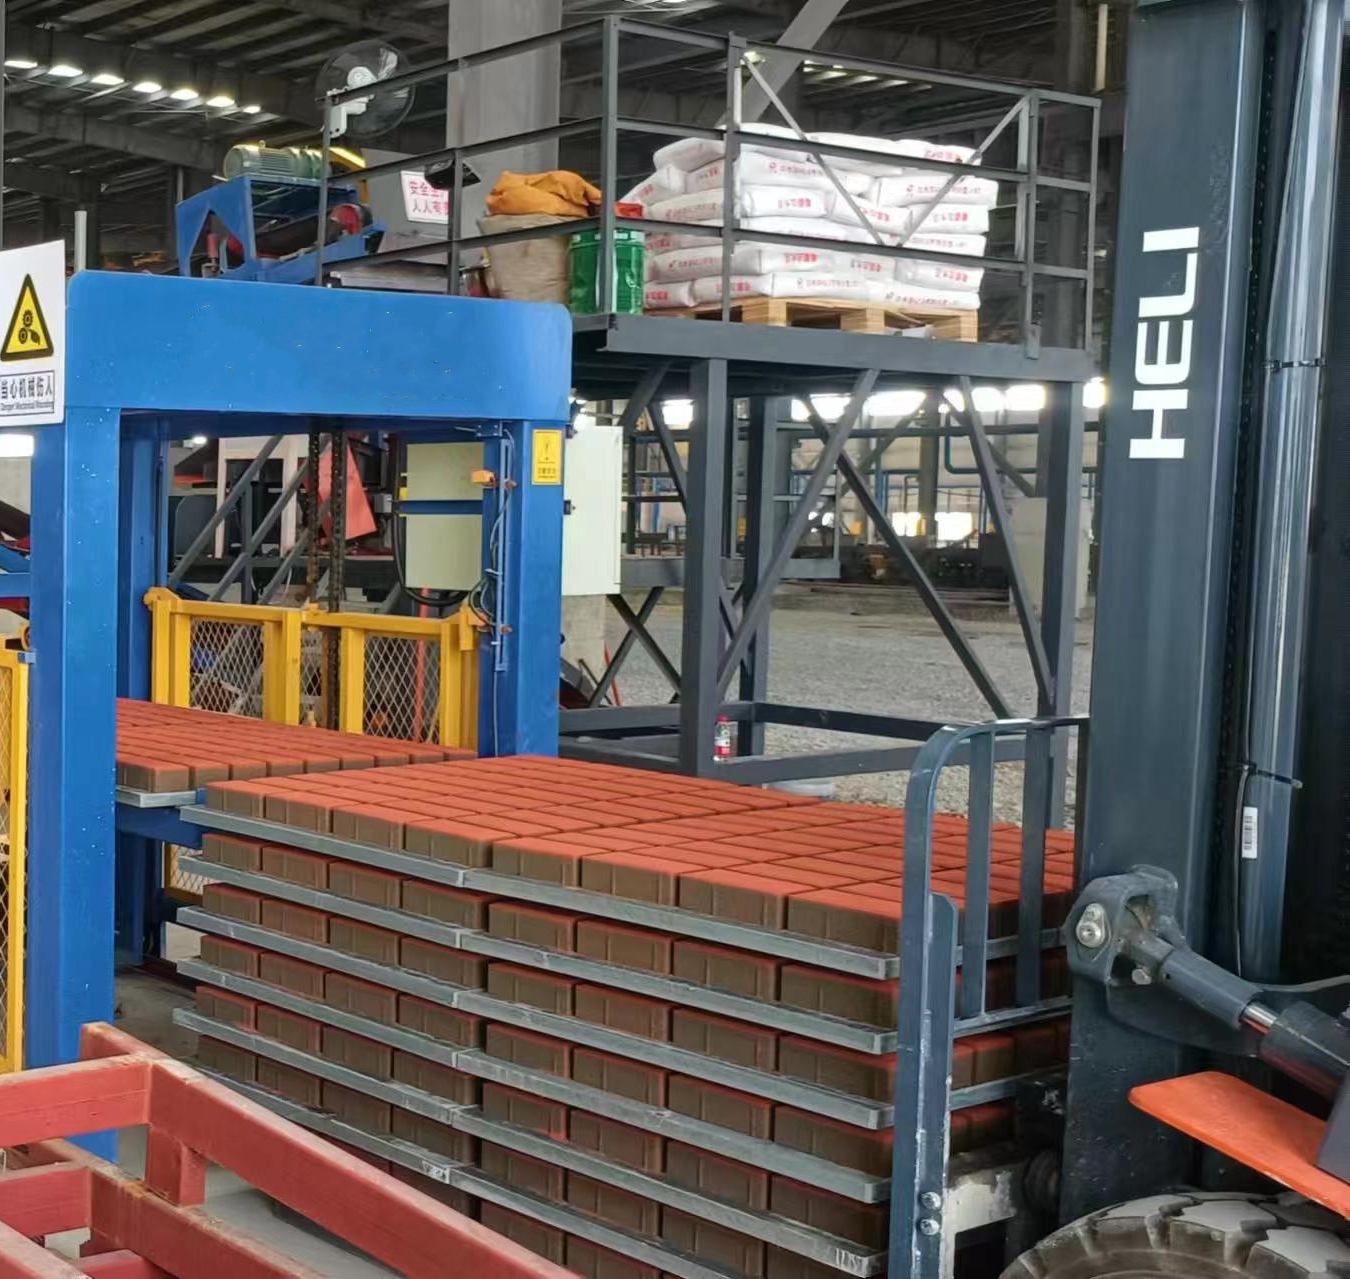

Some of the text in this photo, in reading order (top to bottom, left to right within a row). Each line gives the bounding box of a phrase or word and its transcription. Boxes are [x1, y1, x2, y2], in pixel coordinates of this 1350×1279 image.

[1, 376, 52, 399] 当心机械伤人
[1129, 227, 1199, 459] HELI
